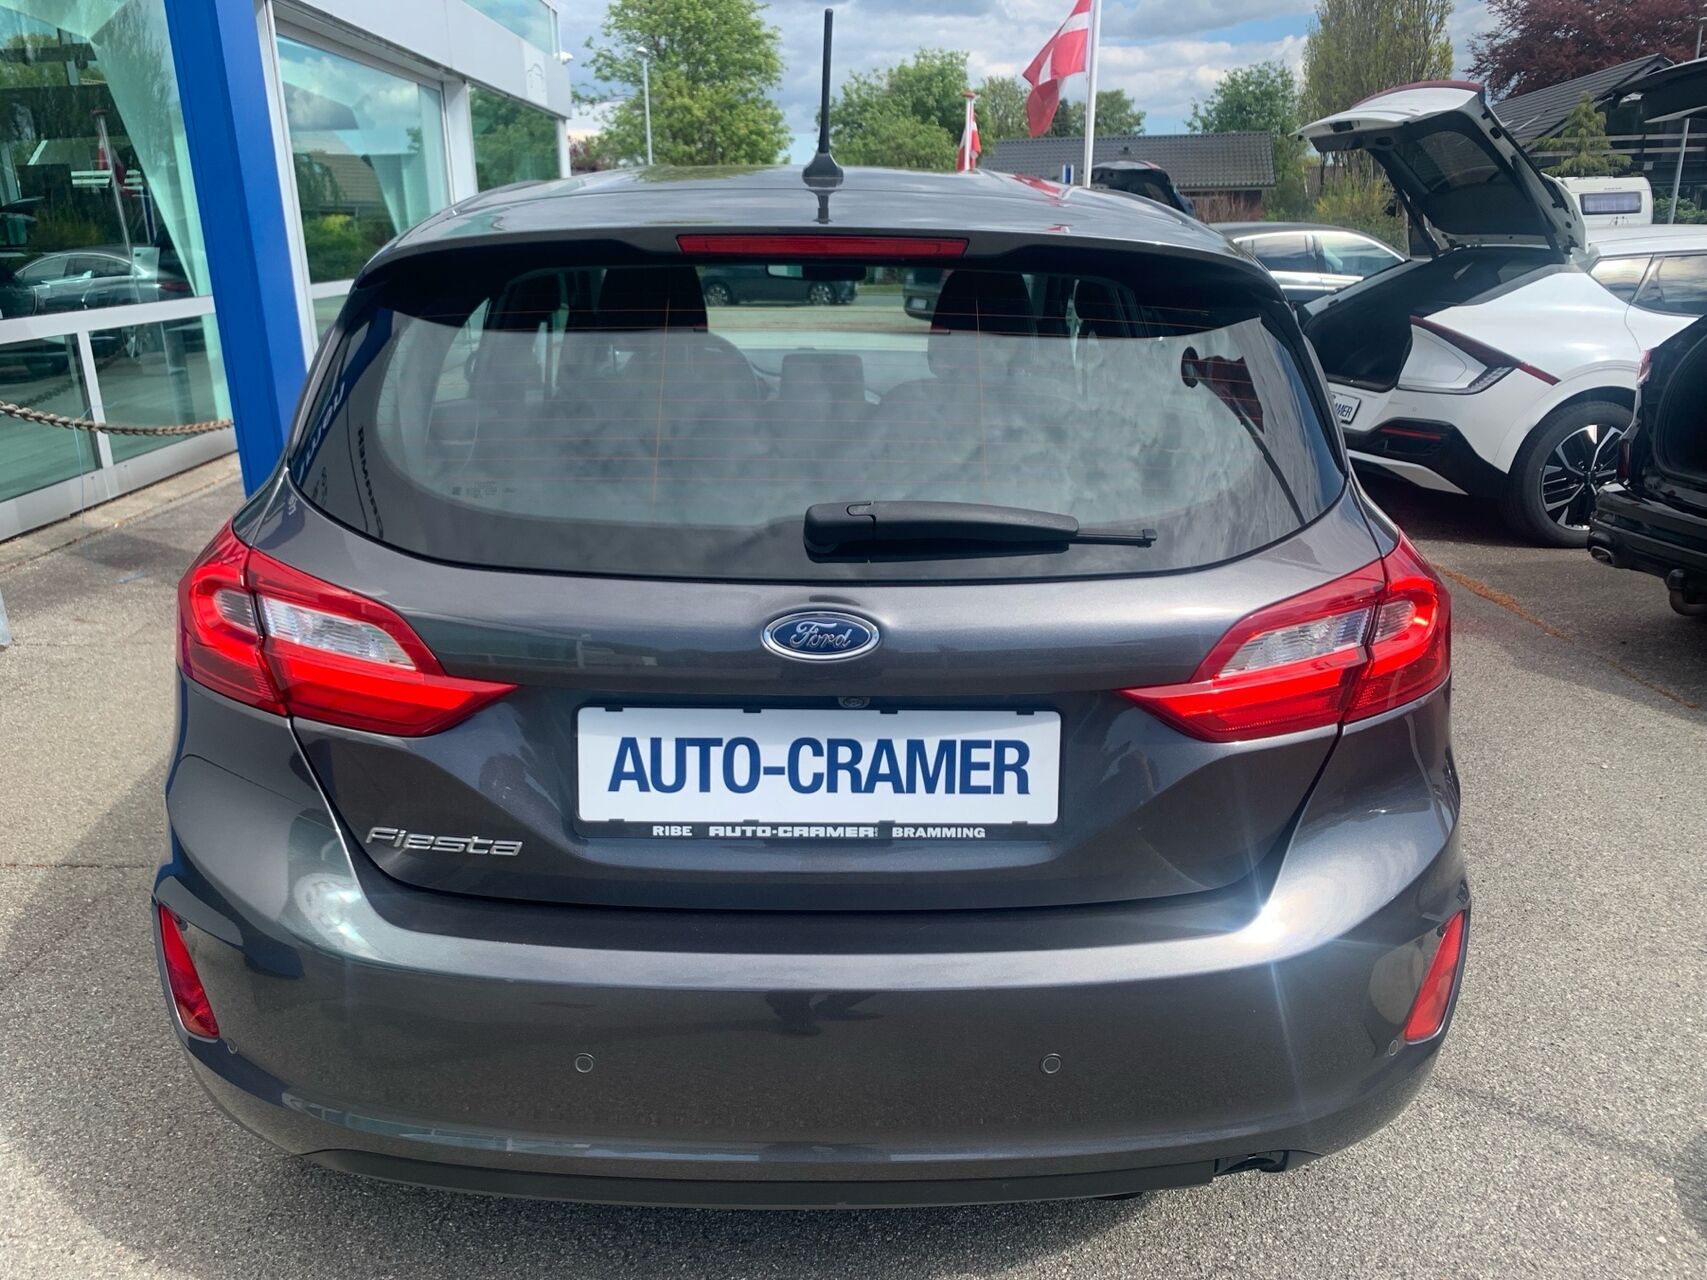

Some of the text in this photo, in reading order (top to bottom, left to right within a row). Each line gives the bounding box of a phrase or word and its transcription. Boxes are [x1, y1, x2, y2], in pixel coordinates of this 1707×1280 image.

[789, 621, 853, 649] Ford
[607, 736, 1031, 795] AUTO-CRAMER
[365, 826, 524, 857] Fiesta
[652, 825, 693, 837] RIBE
[708, 826, 875, 838] AUTO-CRAMER
[891, 826, 986, 839] BRAMMING
